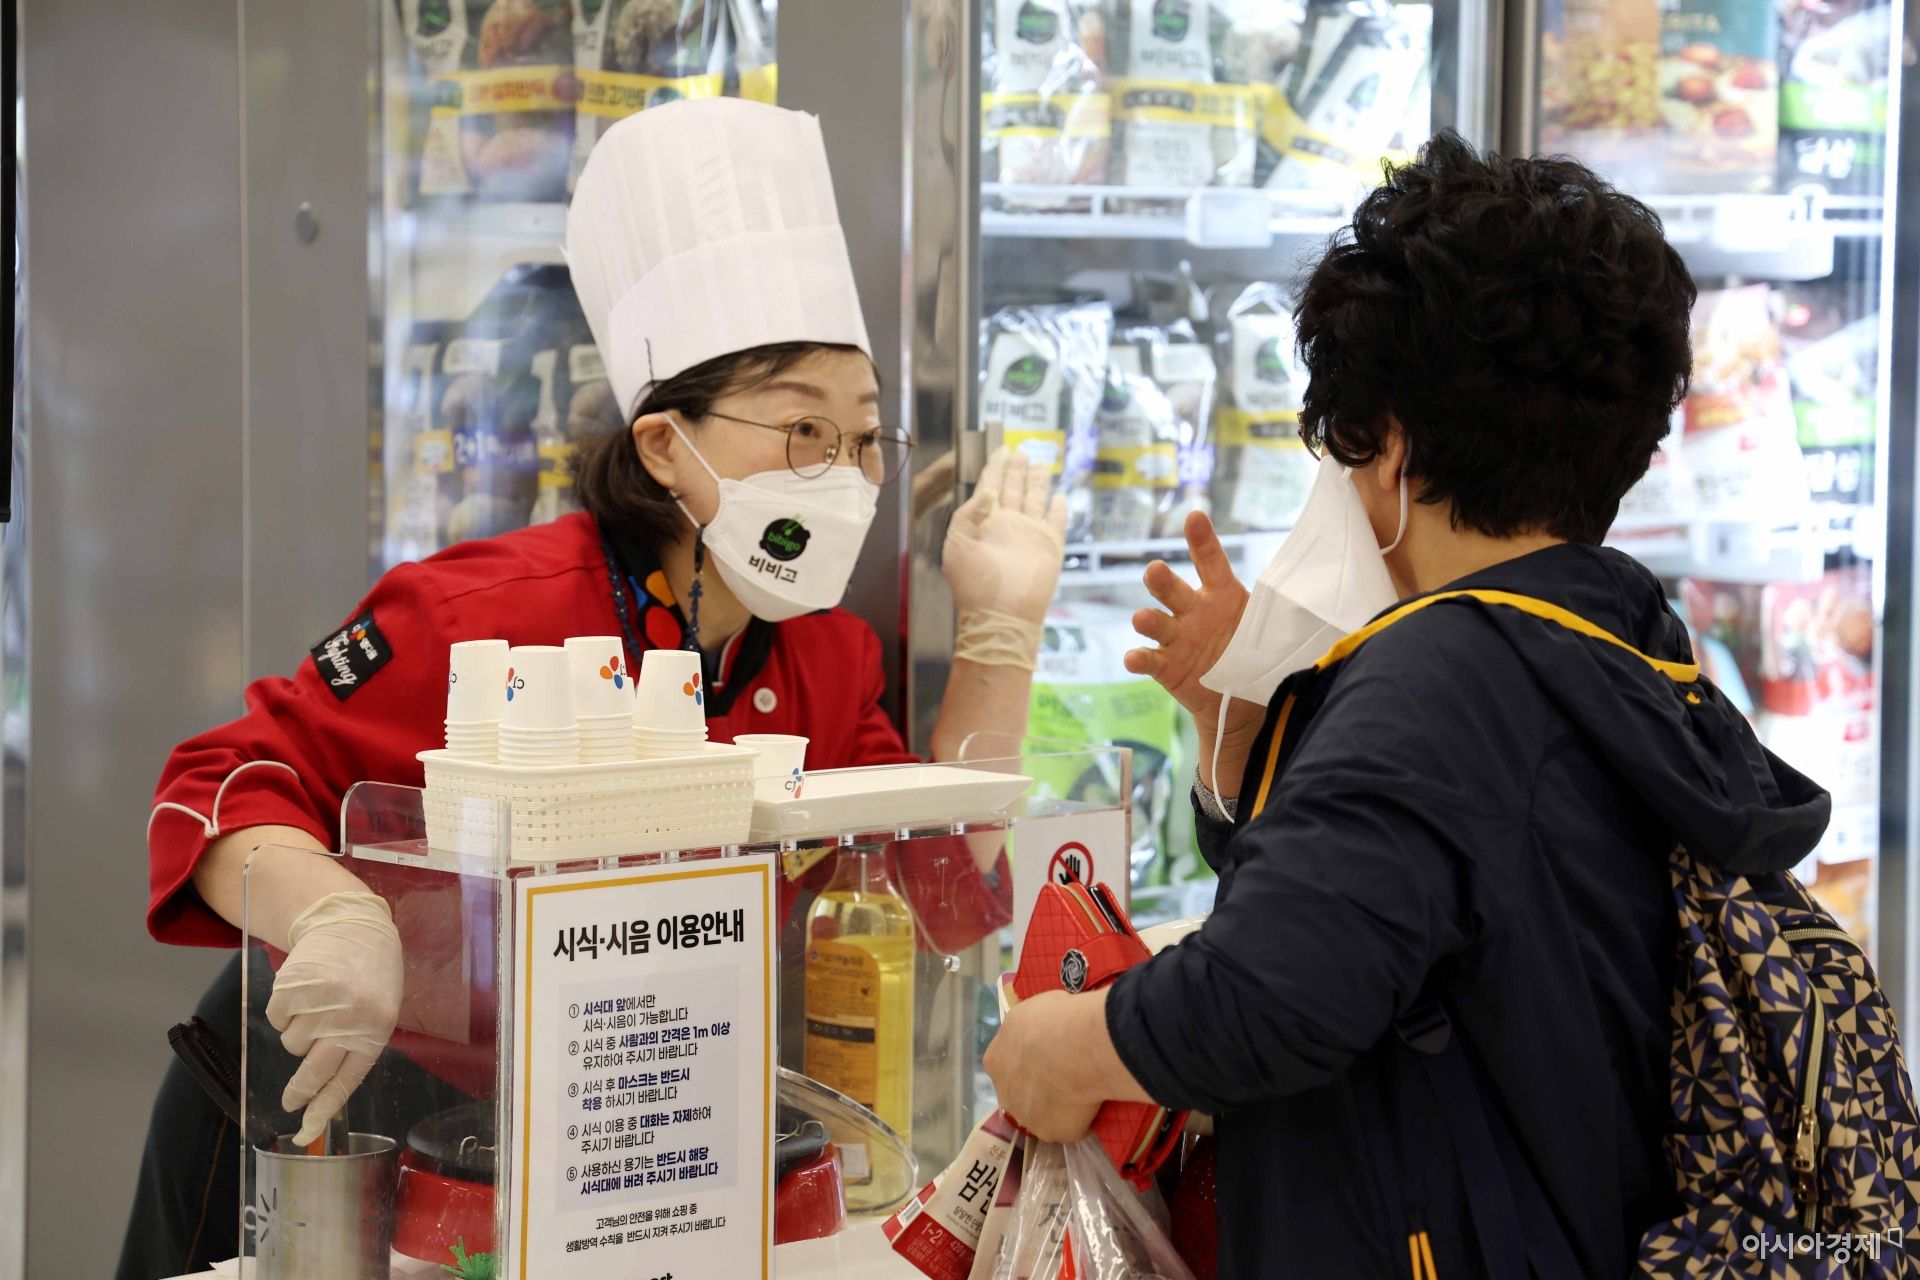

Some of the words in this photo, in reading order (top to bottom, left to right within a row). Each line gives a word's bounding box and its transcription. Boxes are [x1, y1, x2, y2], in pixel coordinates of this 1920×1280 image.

[748, 555, 798, 583] 비비고
[317, 630, 358, 686] Fighting
[512, 676, 525, 690] CJ
[784, 780, 797, 793] CJ
[553, 920, 651, 961] 시식·시음
[657, 909, 744, 949] 이용안내
[583, 1000, 613, 1015] 시식대
[616, 994, 656, 1013] 앞에서만
[583, 1013, 636, 1032] 시식·시음이
[639, 1007, 688, 1026] 가능합니다
[583, 1039, 603, 1053] 시식
[606, 1036, 616, 1050] 중
[619, 1030, 659, 1048] 사람과의
[662, 1027, 690, 1043] 간격은
[693, 1026, 708, 1038] 1m
[711, 1022, 730, 1036] 이상
[583, 1052, 623, 1070] 유지하여
[626, 1048, 655, 1064] 주시기
[658, 1043, 698, 1060] 바랍니다
[583, 1080, 602, 1094] 시식
[605, 1078, 615, 1091] 후
[618, 1072, 657, 1090] 마스크는
[661, 1068, 690, 1084] 반드시
[582, 1097, 602, 1111] 착용
[605, 1092, 635, 1108] 하시기
[638, 1086, 678, 1104] 바랍니다
[582, 1122, 601, 1137] 시식
[605, 1118, 624, 1134] 이용
[627, 1117, 637, 1131] 중
[640, 1113, 670, 1128] 대화는
[673, 1106, 711, 1123] 자제하여
[581, 1138, 611, 1154] 주시기
[614, 1131, 654, 1149] 바랍니다
[581, 1160, 621, 1178] 사용하신
[624, 1156, 654, 1172] 용기는
[656, 1151, 686, 1166] 반드시
[689, 1147, 709, 1161] 해당
[581, 1177, 621, 1195] 시식대에
[624, 1173, 643, 1188] 버려
[647, 1168, 675, 1185] 주시기
[679, 1162, 718, 1179] 바랍니다
[596, 1214, 628, 1230] 고객님의
[629, 1210, 653, 1224] 안전을
[655, 1208, 670, 1220] 위해
[672, 1205, 688, 1217] 쇼핑
[689, 1204, 697, 1215] 중
[566, 1237, 597, 1253] 생활방역
[599, 1233, 624, 1247] 수칙을
[627, 1228, 650, 1242] 반드시
[653, 1225, 668, 1238] 지켜
[670, 1222, 693, 1236] 주시기
[695, 1216, 726, 1231] 바랍니다
